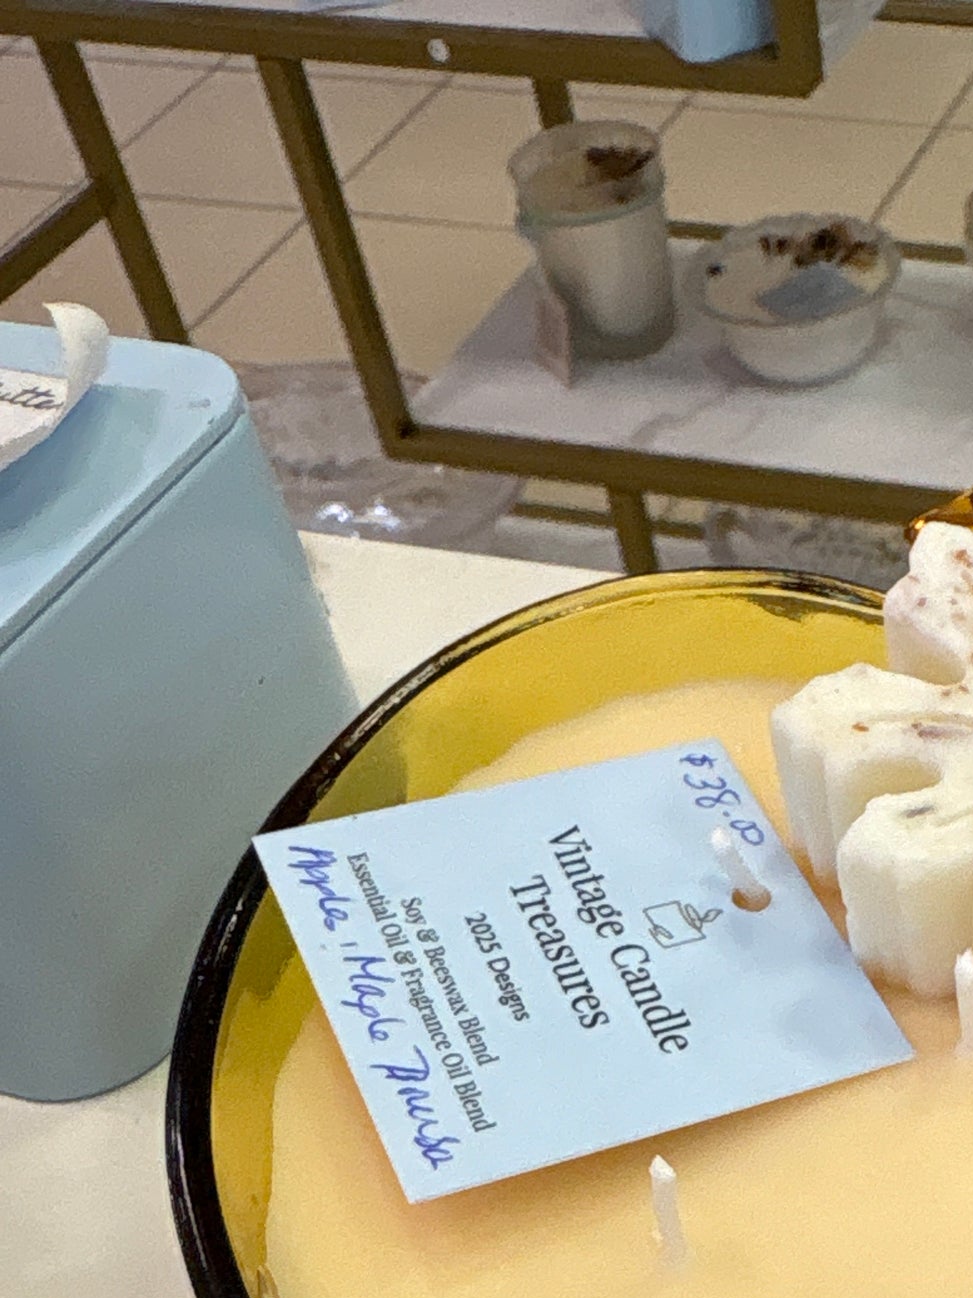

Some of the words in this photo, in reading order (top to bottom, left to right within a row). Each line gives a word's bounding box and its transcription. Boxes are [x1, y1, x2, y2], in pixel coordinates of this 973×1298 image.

[347, 851, 391, 923] Essential
[400, 897, 428, 927] Soy
[381, 922, 410, 957] Oil
[393, 946, 418, 967] &
[416, 922, 440, 944] &
[509, 874, 610, 1029] Treasures
[548, 824, 625, 939] Vintage
[610, 943, 692, 1055] Candle
[423, 945, 471, 1017] Beeswax
[464, 911, 503, 954] 2025
[486, 956, 531, 1022] Designs
[400, 966, 453, 1052] Fragrance
[441, 1051, 466, 1081] Oil
[457, 1015, 501, 1067] Blend
[453, 1078, 498, 1134] Blend
